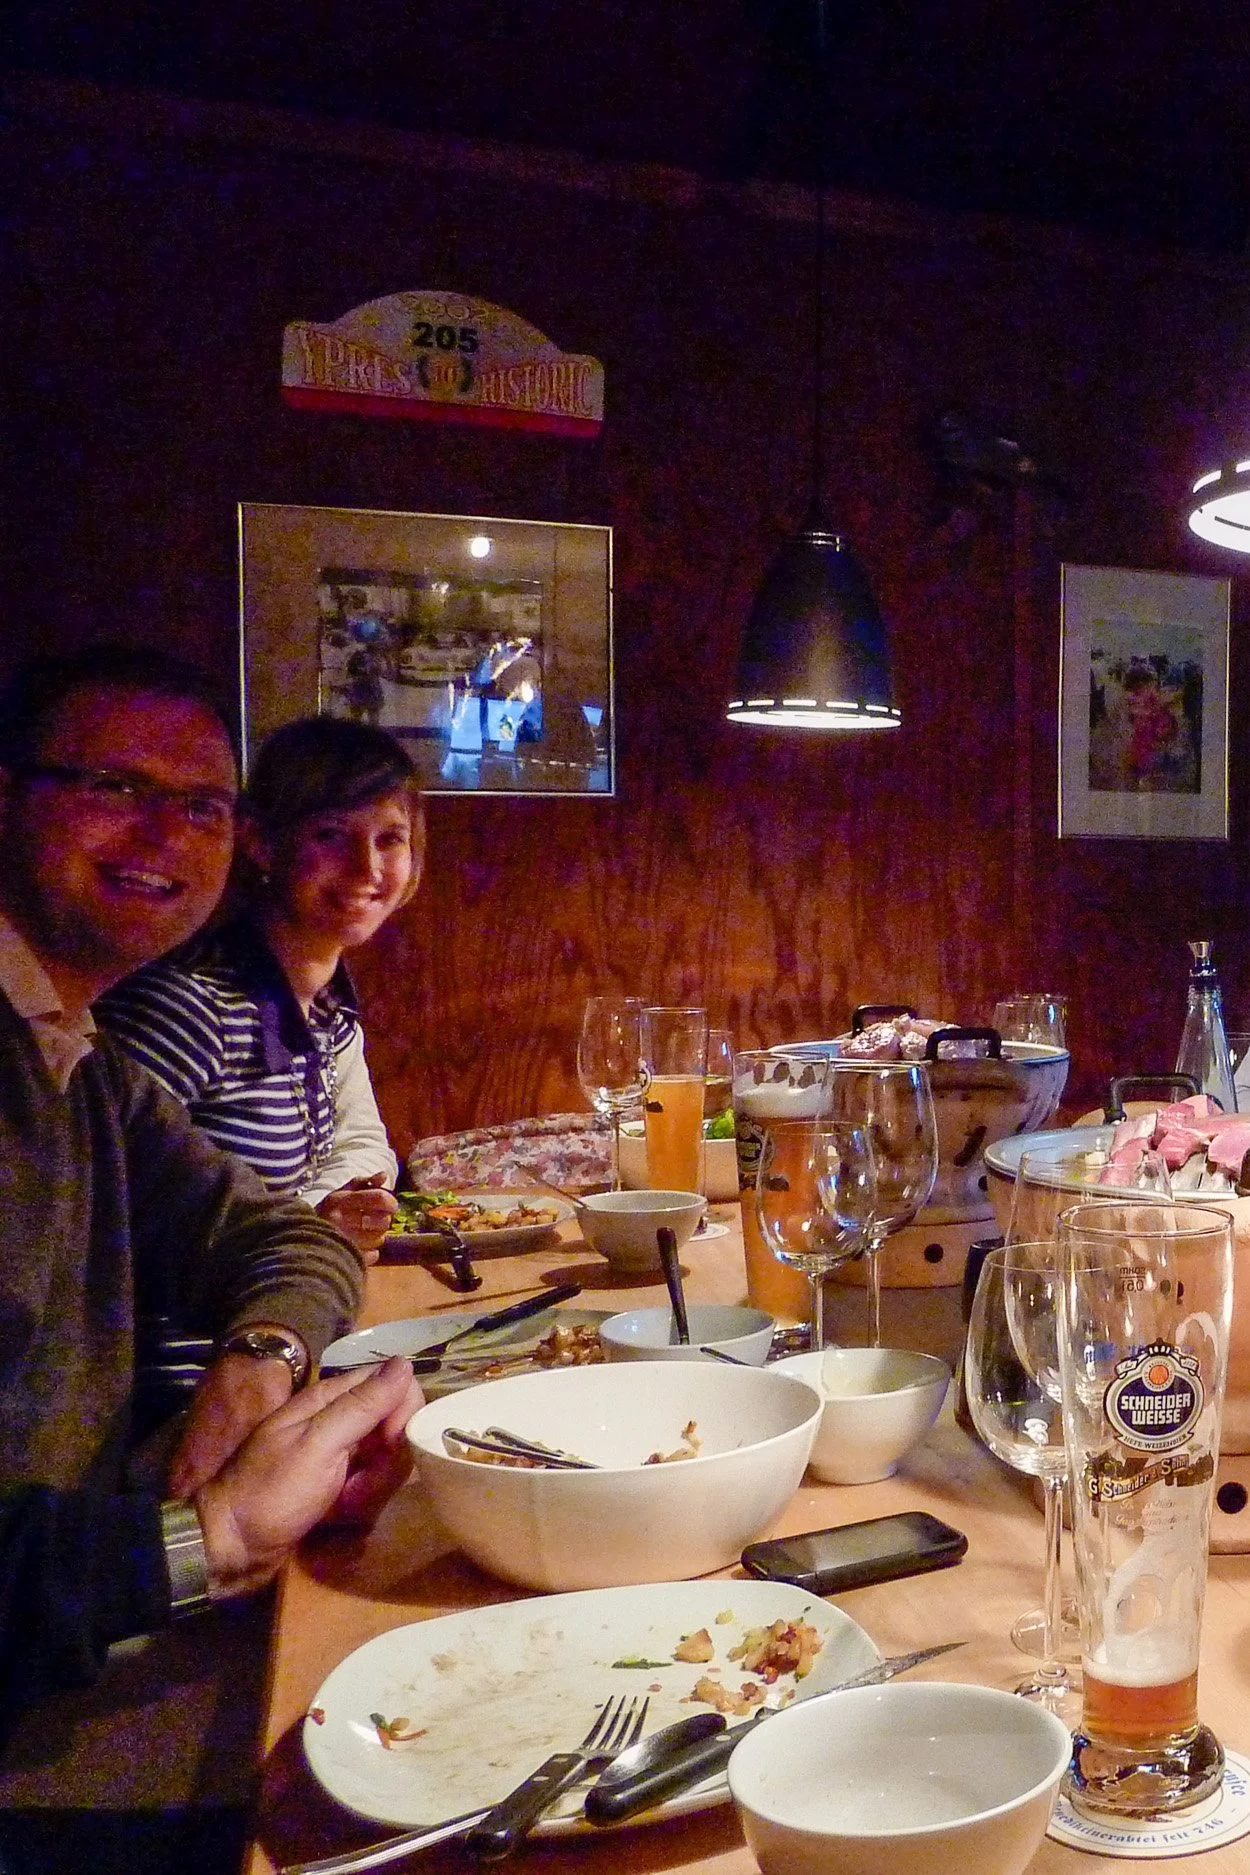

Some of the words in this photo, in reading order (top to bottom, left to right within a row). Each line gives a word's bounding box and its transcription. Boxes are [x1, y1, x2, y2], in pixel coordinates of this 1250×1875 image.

[412, 321, 480, 353] 205
[1121, 1393, 1191, 1411] SCHNEIDER
[1131, 1409, 1181, 1426] WEISSE
[1102, 1471, 1150, 1498] Schneider
